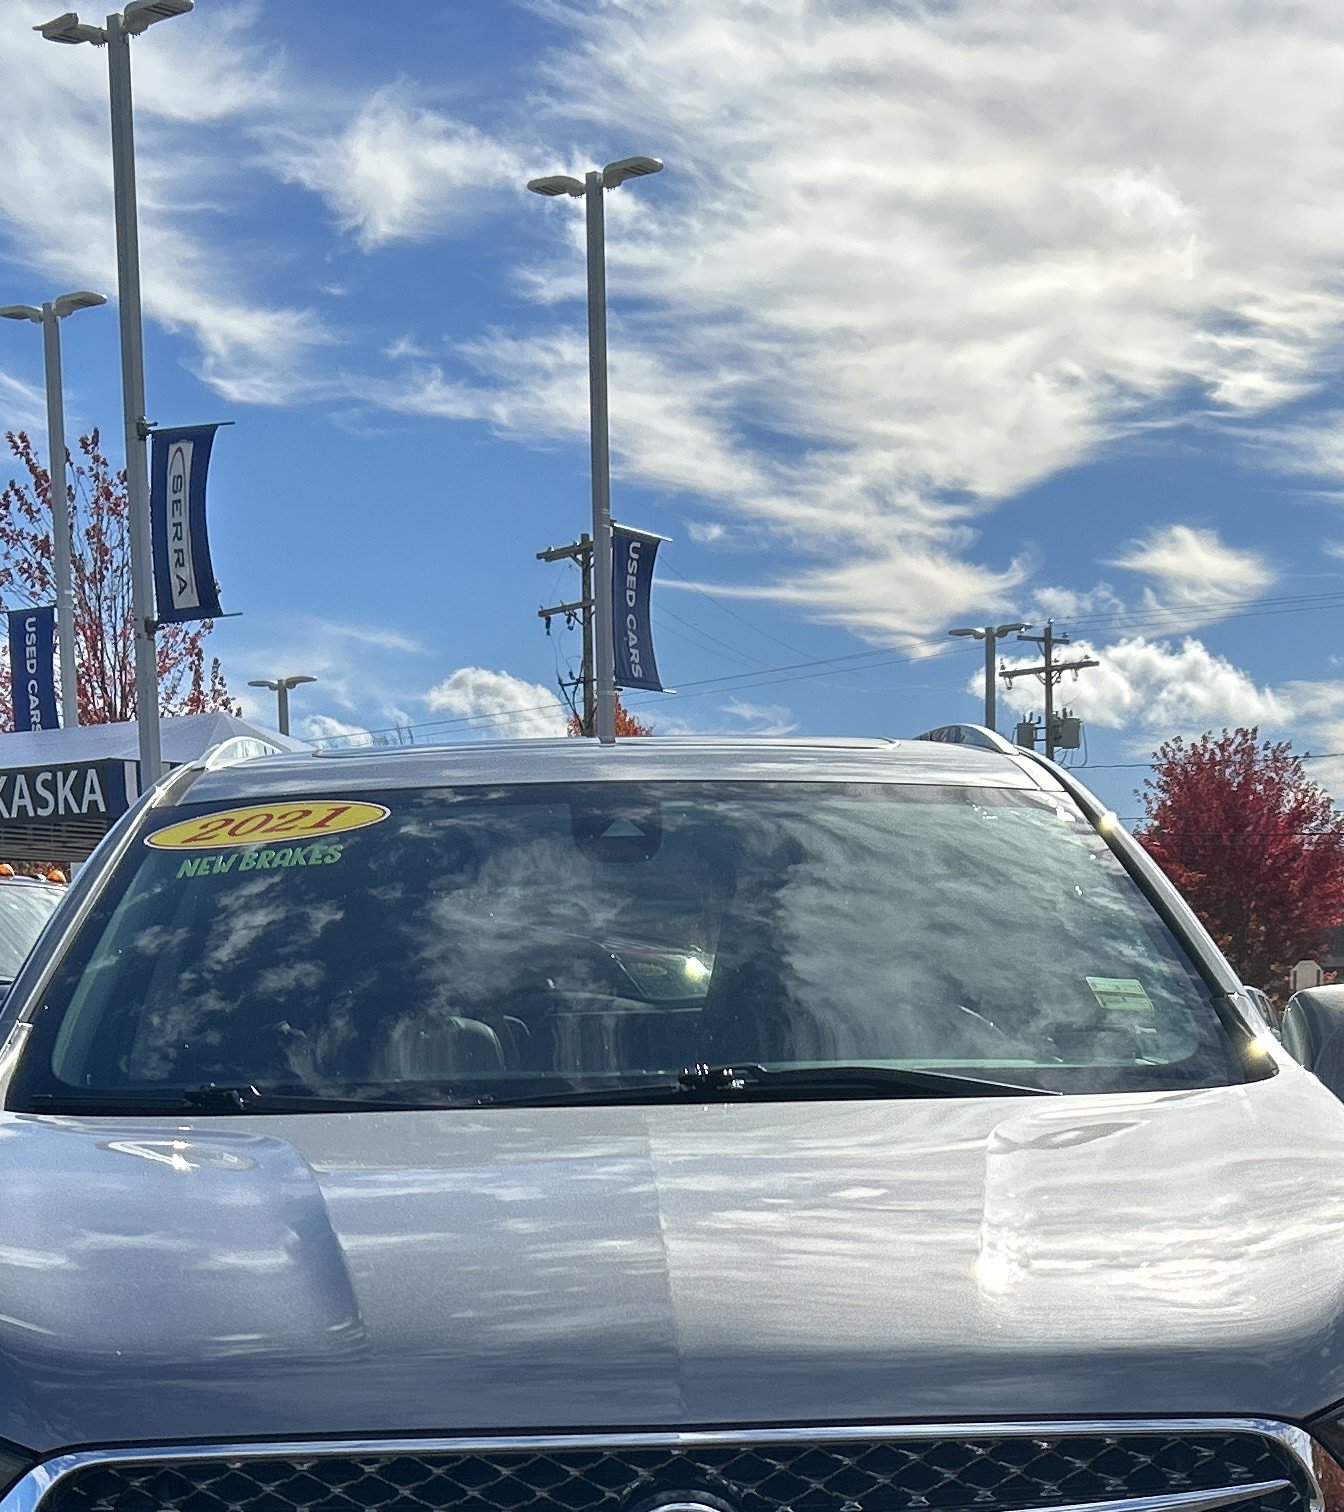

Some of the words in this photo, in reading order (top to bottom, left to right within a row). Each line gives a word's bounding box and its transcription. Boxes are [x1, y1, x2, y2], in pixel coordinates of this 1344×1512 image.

[171, 473, 189, 597] SERRA
[627, 541, 641, 608] USED
[24, 616, 37, 675] USED
[626, 613, 643, 679] CARS
[180, 805, 352, 844] 2021
[175, 852, 238, 879] NEW
[238, 842, 345, 872] BRAKES
